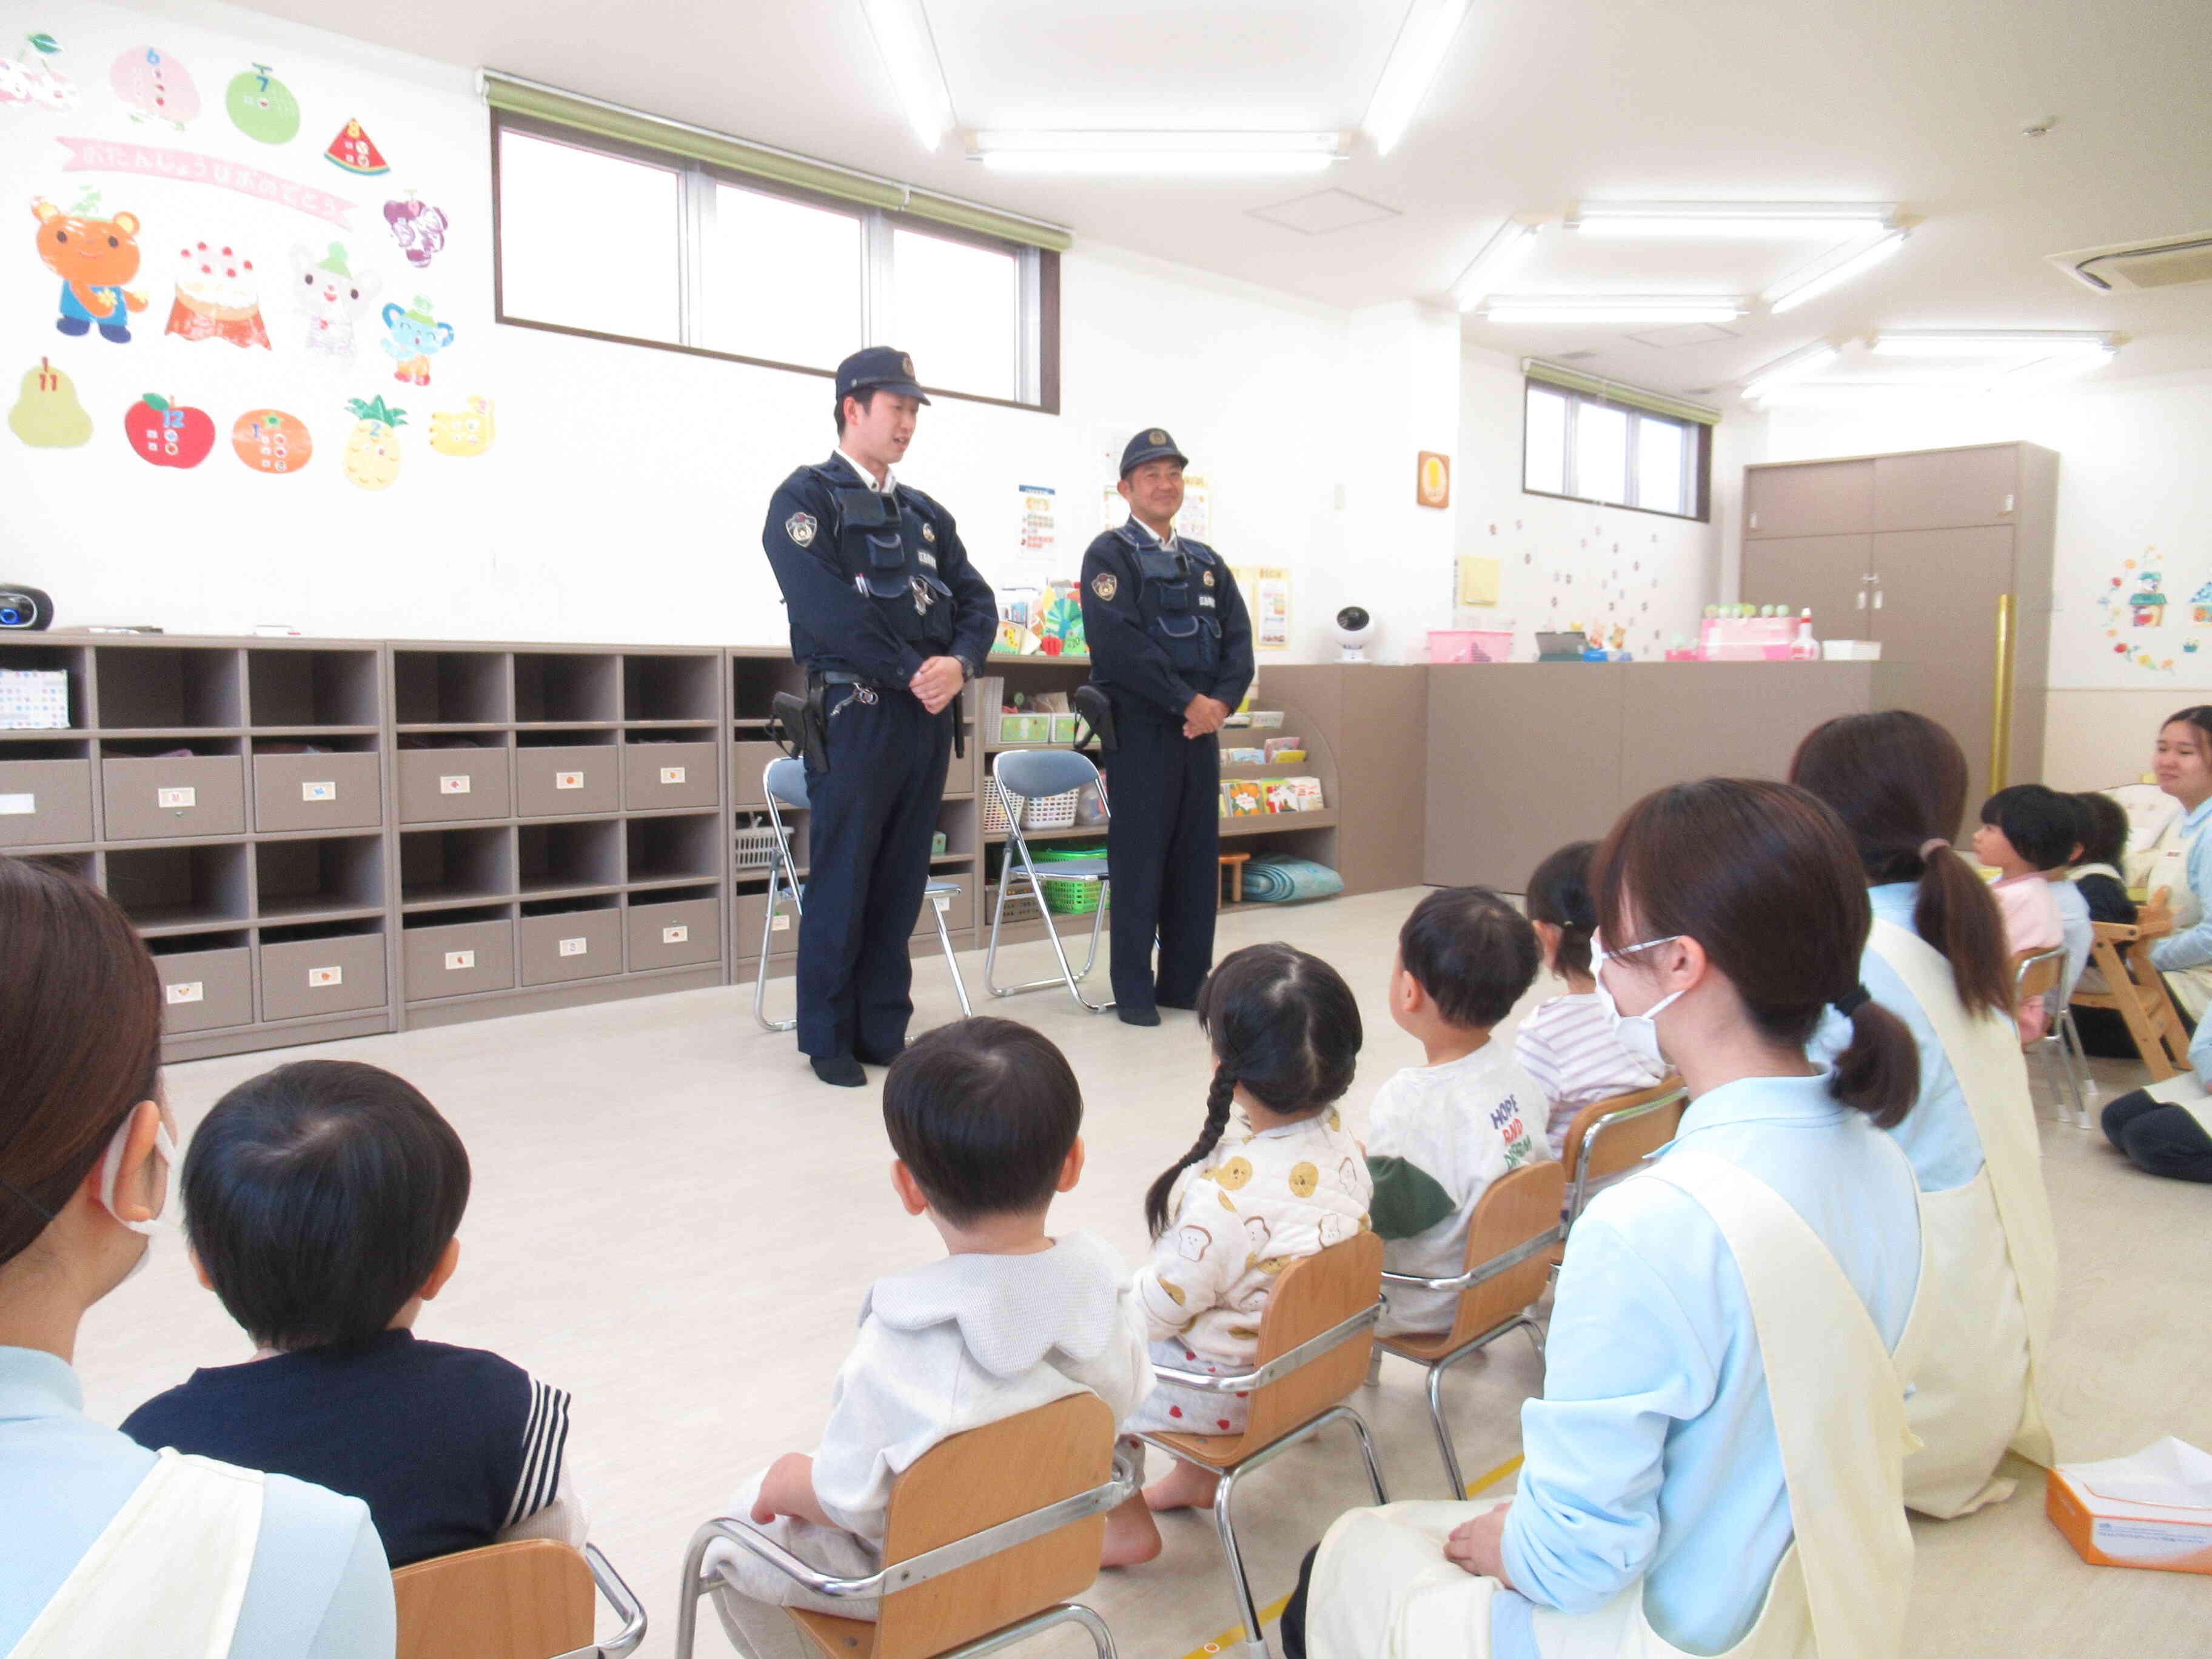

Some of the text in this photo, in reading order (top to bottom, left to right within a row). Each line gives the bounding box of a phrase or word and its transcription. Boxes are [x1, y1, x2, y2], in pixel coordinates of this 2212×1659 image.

[147, 47, 161, 65] 6
[256, 75, 270, 92] 7
[347, 121, 361, 139] 8
[407, 201, 420, 216] 9
[39, 374, 58, 391] 11
[163, 410, 185, 427] 12
[1490, 1094, 1519, 1130] HOPE
[1503, 1118, 1524, 1146] AND
